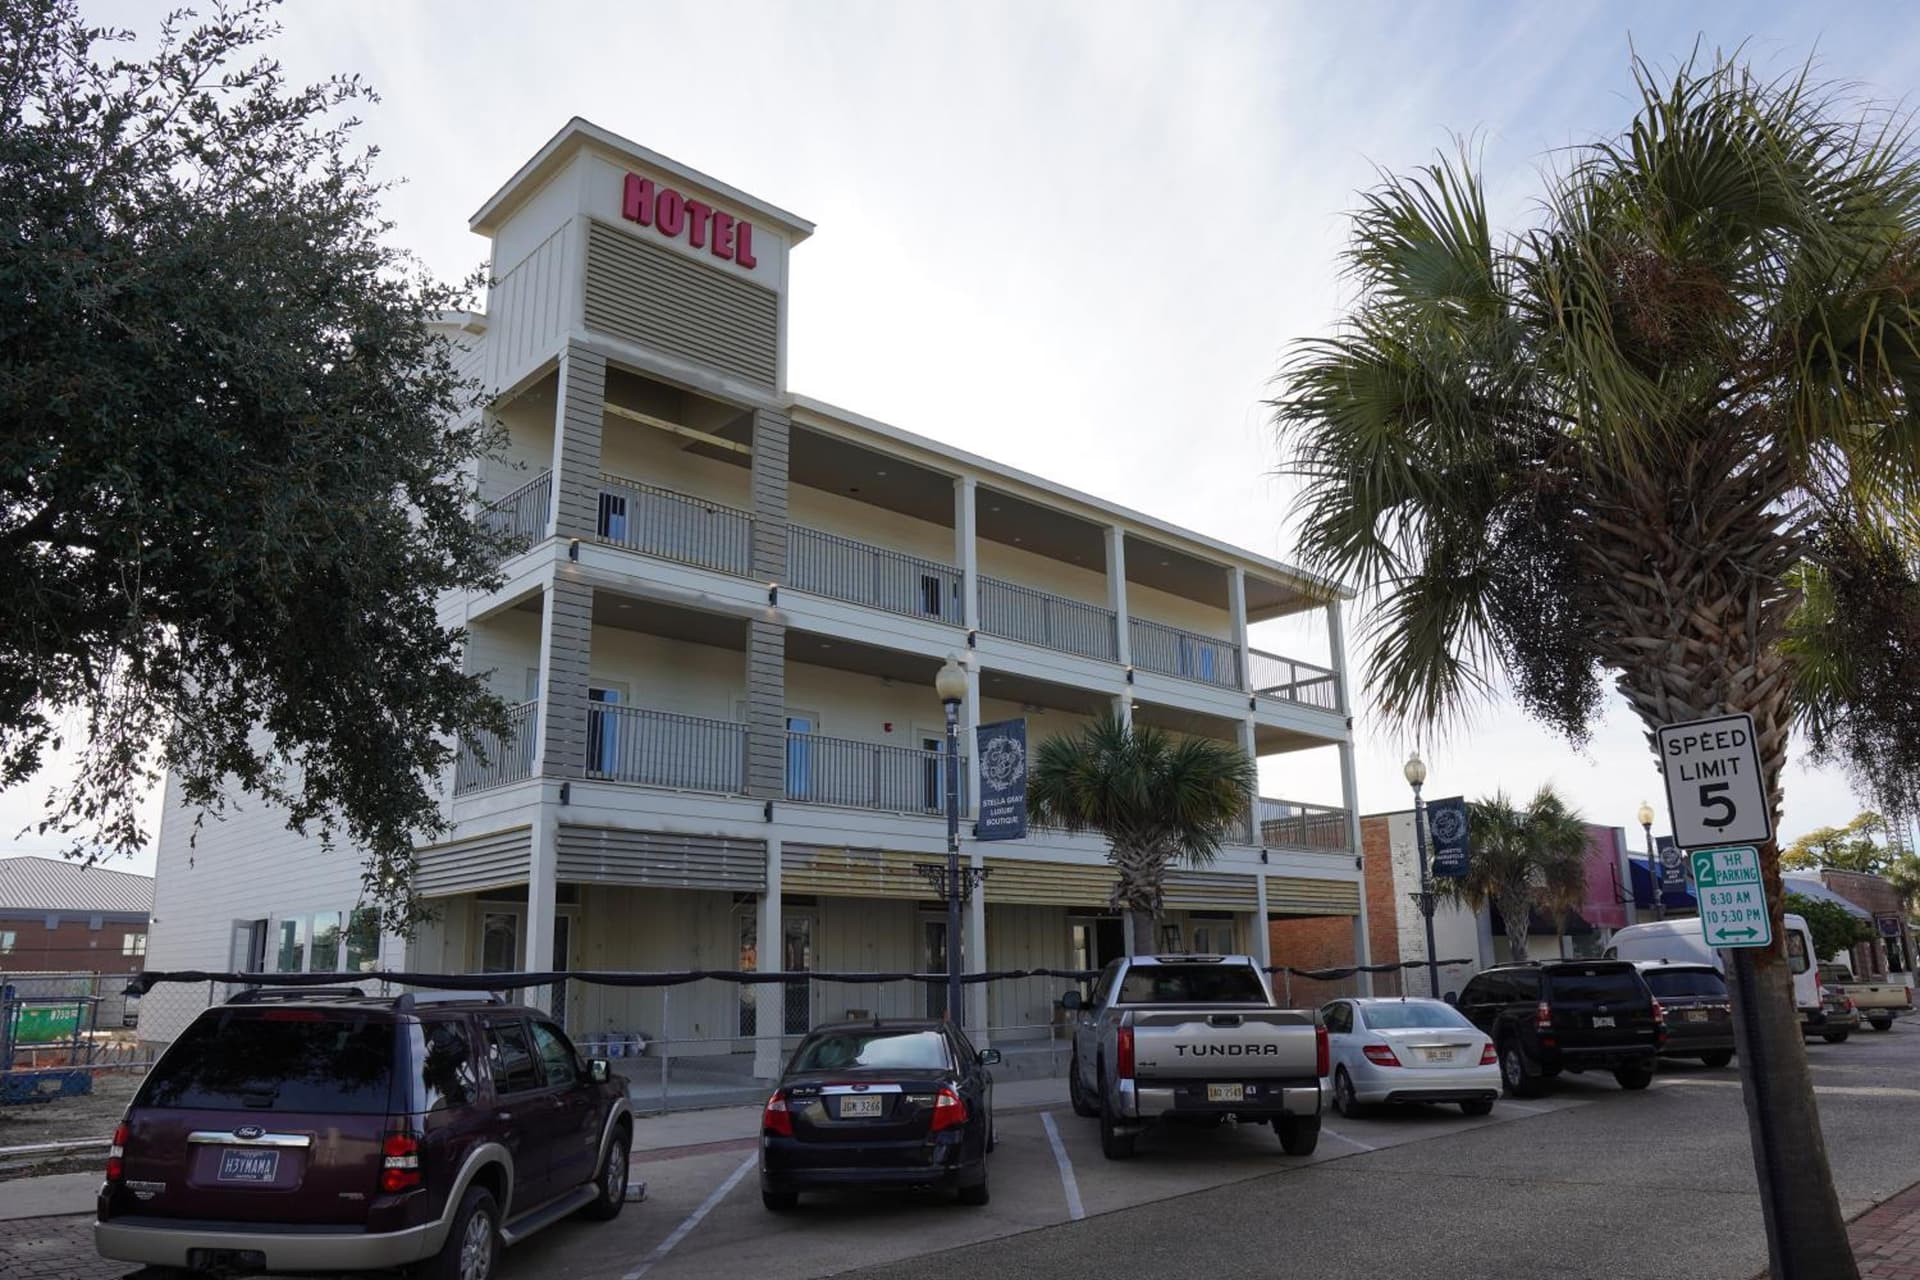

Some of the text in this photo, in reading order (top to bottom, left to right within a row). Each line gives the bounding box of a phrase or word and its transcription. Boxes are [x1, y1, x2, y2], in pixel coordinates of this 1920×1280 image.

[622, 172, 757, 270] HOTEL
[1668, 729, 1746, 756] SPEED
[1680, 757, 1740, 781] LIMIT
[1699, 782, 1737, 827] 5
[1697, 858, 1713, 881] 2
[1723, 853, 1742, 866] HR
[1716, 868, 1757, 881] PARKING
[1710, 891, 1751, 905] 8:30 AM
[1706, 908, 1761, 923] TO 5:30 PM
[1174, 1044, 1279, 1056] TUNDRA
[225, 1157, 271, 1174] H3YMAMA
